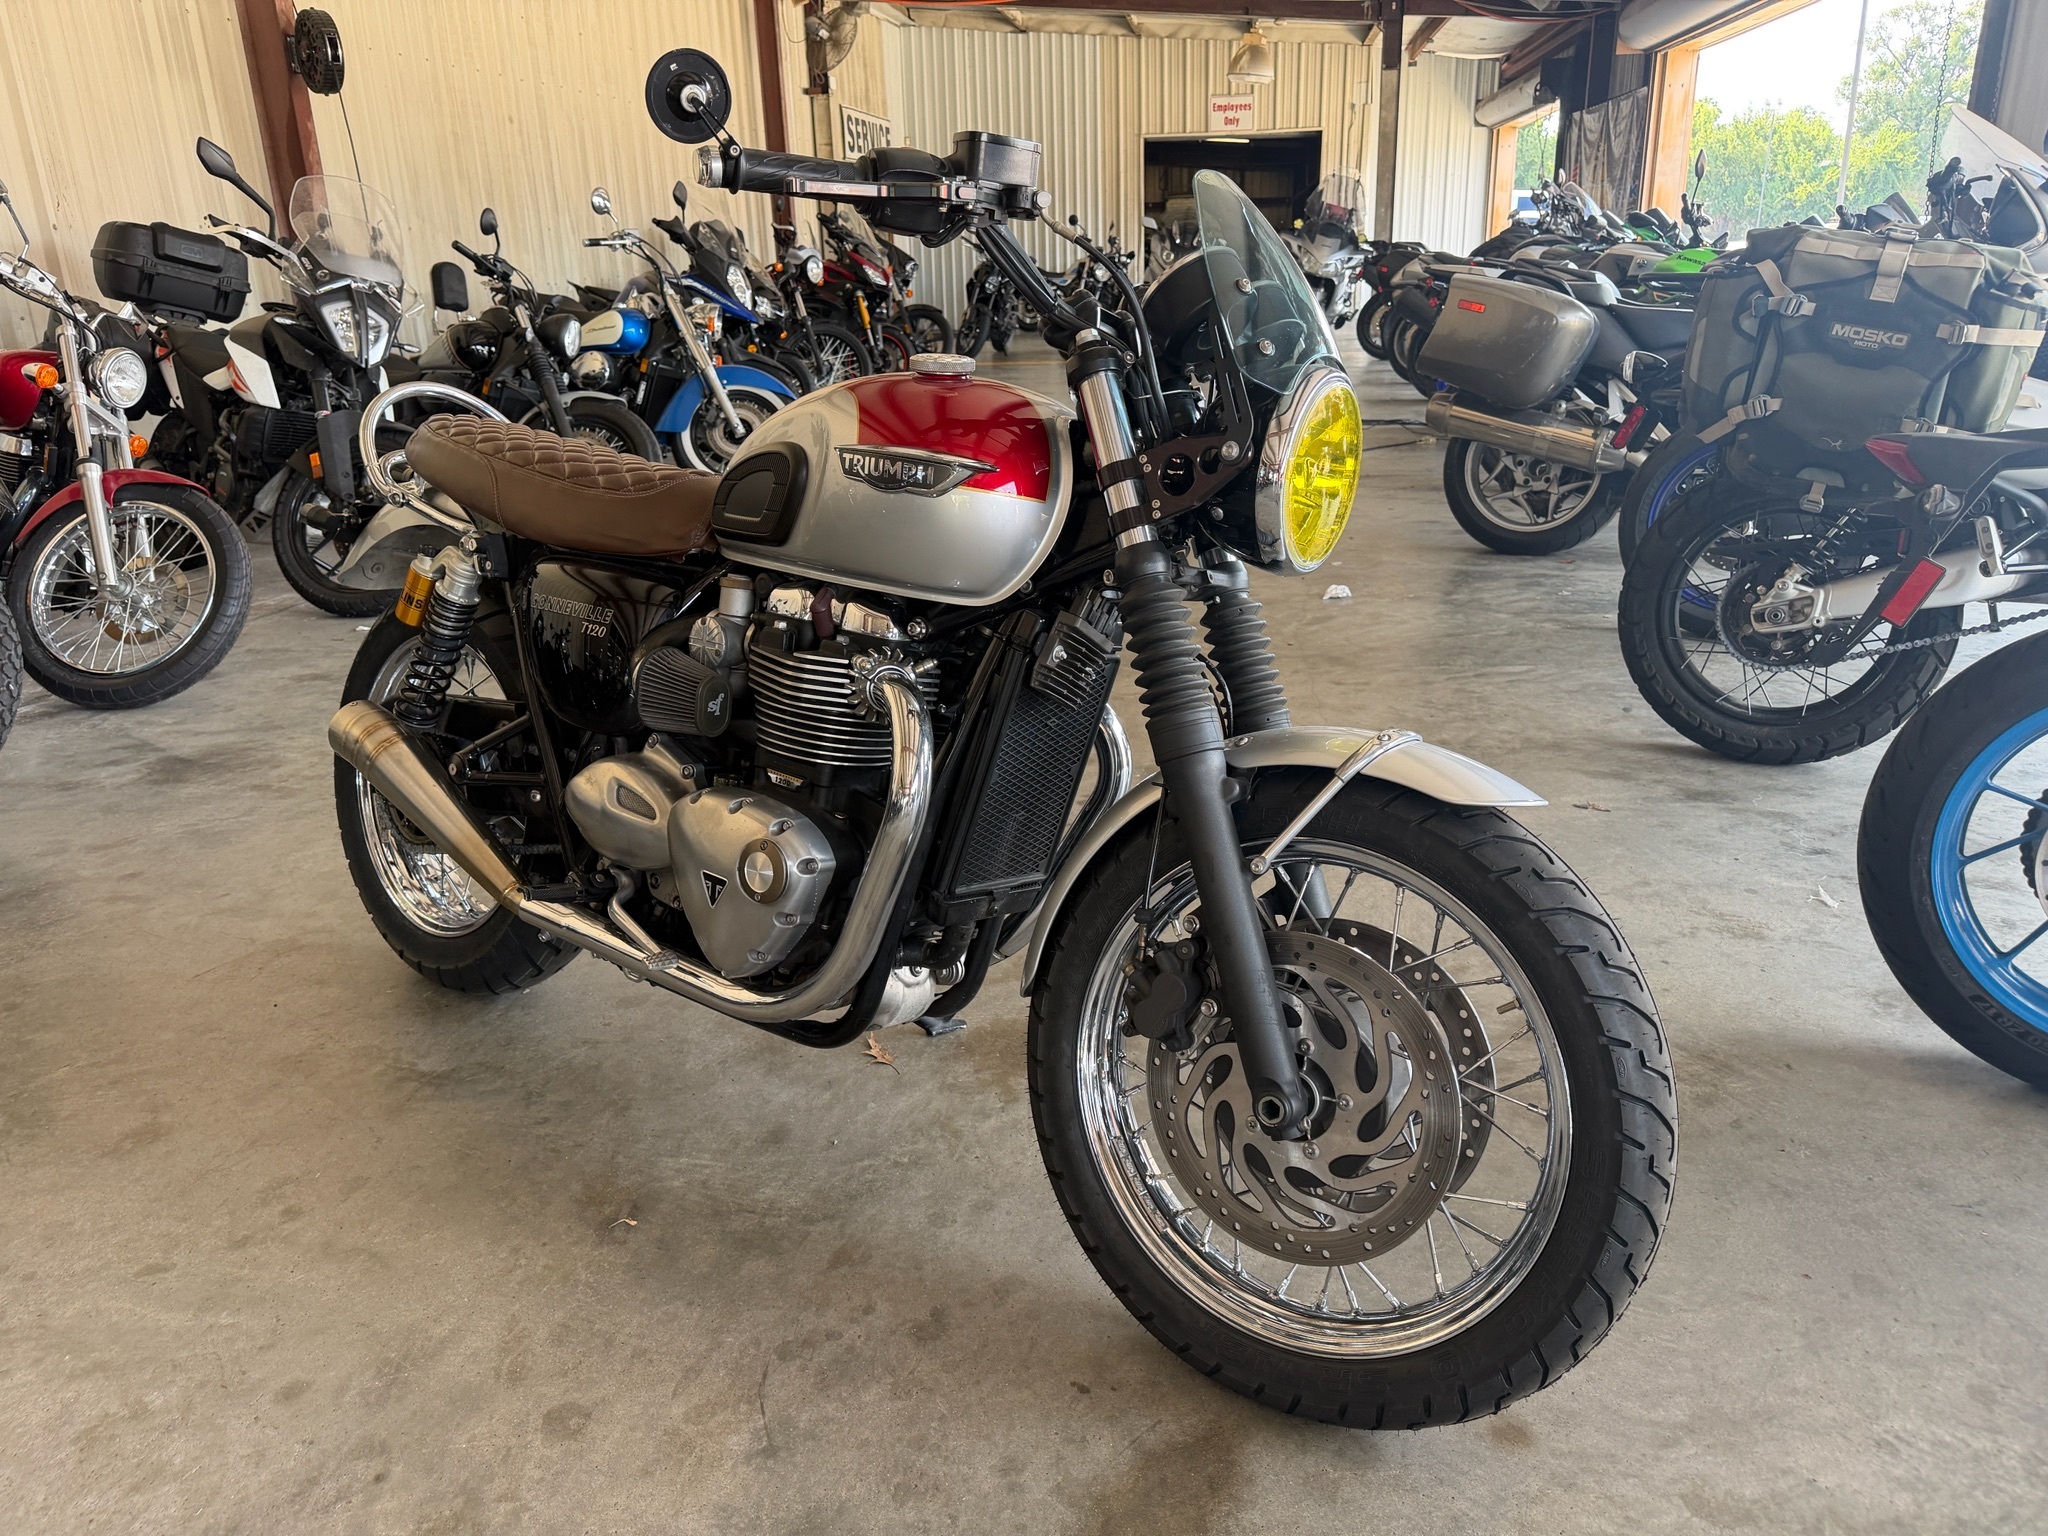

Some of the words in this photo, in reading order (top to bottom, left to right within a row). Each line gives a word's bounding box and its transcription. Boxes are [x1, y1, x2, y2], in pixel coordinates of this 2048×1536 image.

[1212, 101, 1252, 114] Employees
[1223, 116, 1240, 128] Only
[846, 114, 891, 154] SERVICE
[1677, 254, 1707, 266] Kawasa
[1831, 323, 1909, 347] MOSKO
[1853, 340, 1879, 349] MOTO
[842, 452, 935, 487] TRIUMPH
[401, 592, 425, 610] INS
[531, 593, 614, 624] BONNEVILLE
[580, 621, 607, 638] T120
